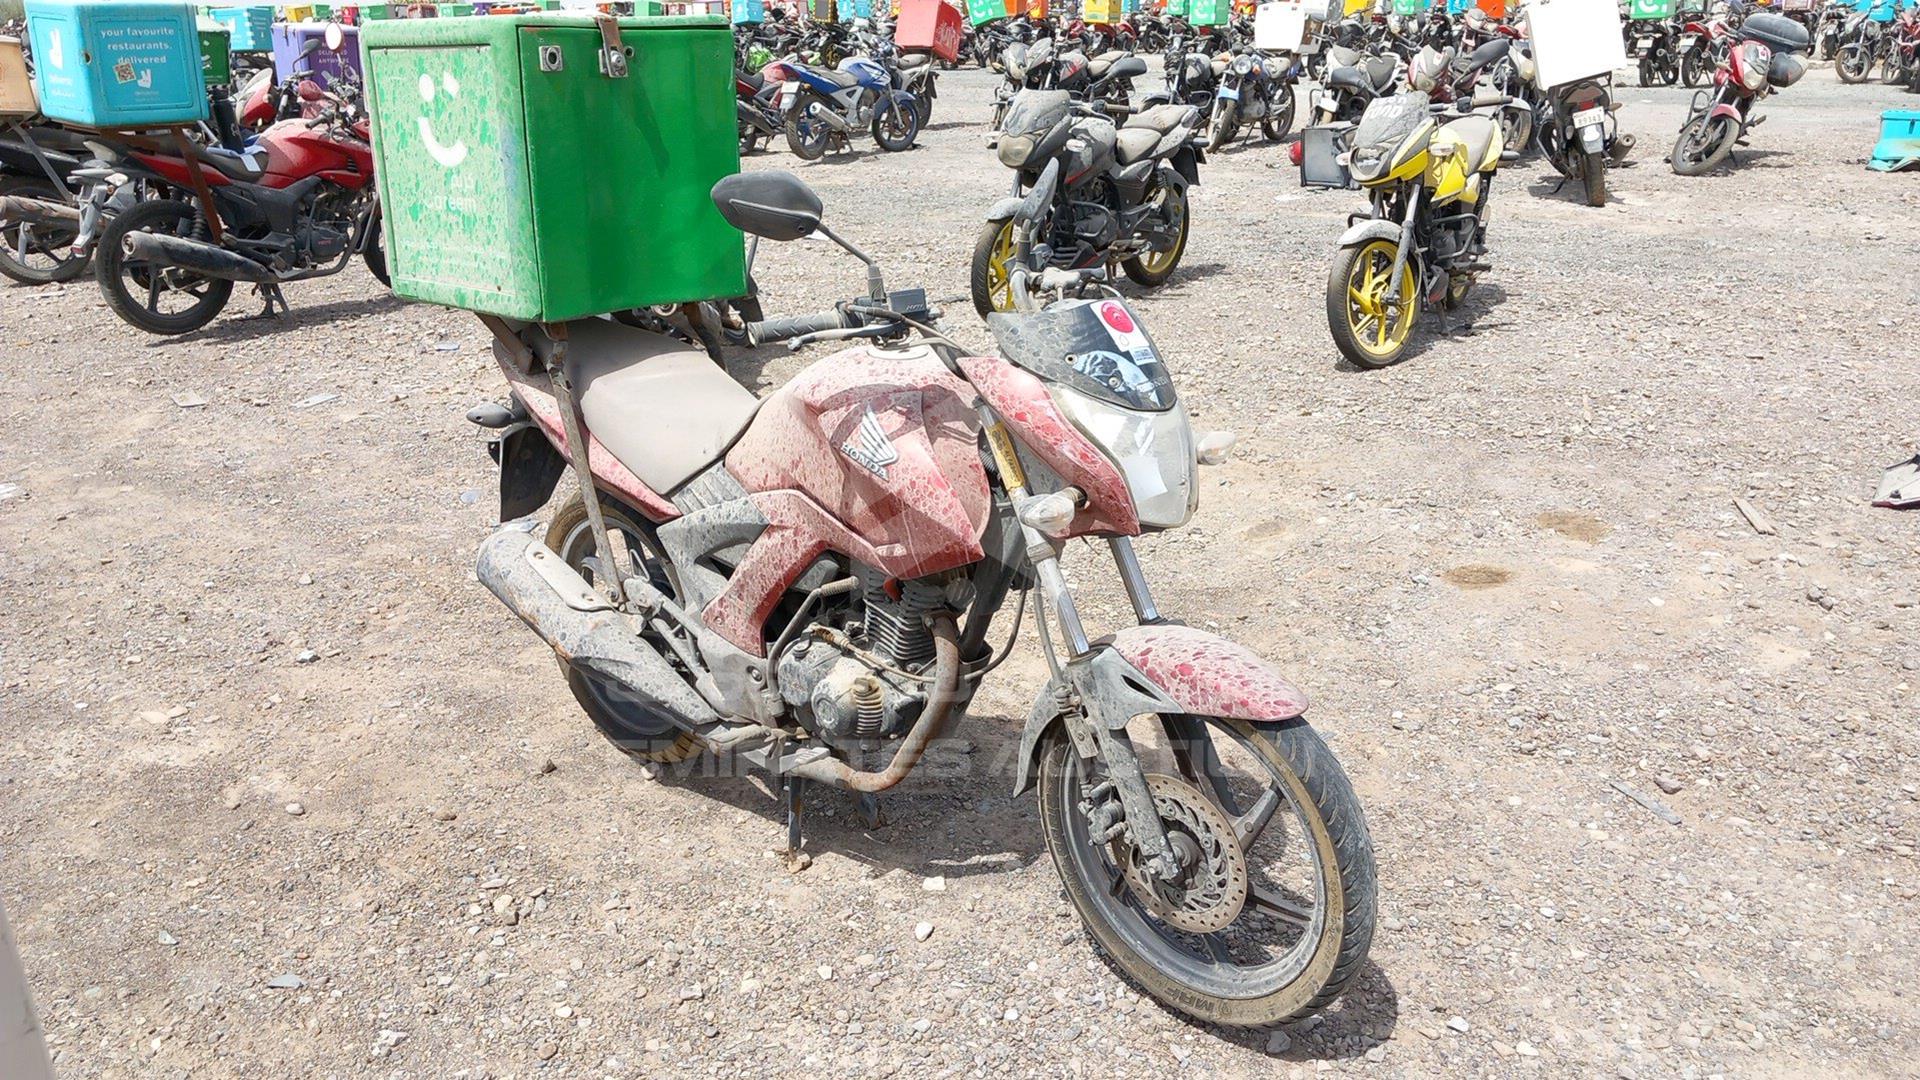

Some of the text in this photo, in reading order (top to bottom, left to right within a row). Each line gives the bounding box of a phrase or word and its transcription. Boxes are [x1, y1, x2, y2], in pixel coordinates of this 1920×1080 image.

[100, 27, 175, 39] your favourite
[107, 41, 173, 51] restaurants.
[117, 55, 167, 64] delivered
[840, 442, 889, 482] HONDA
[1164, 986, 1215, 1013] MRF
